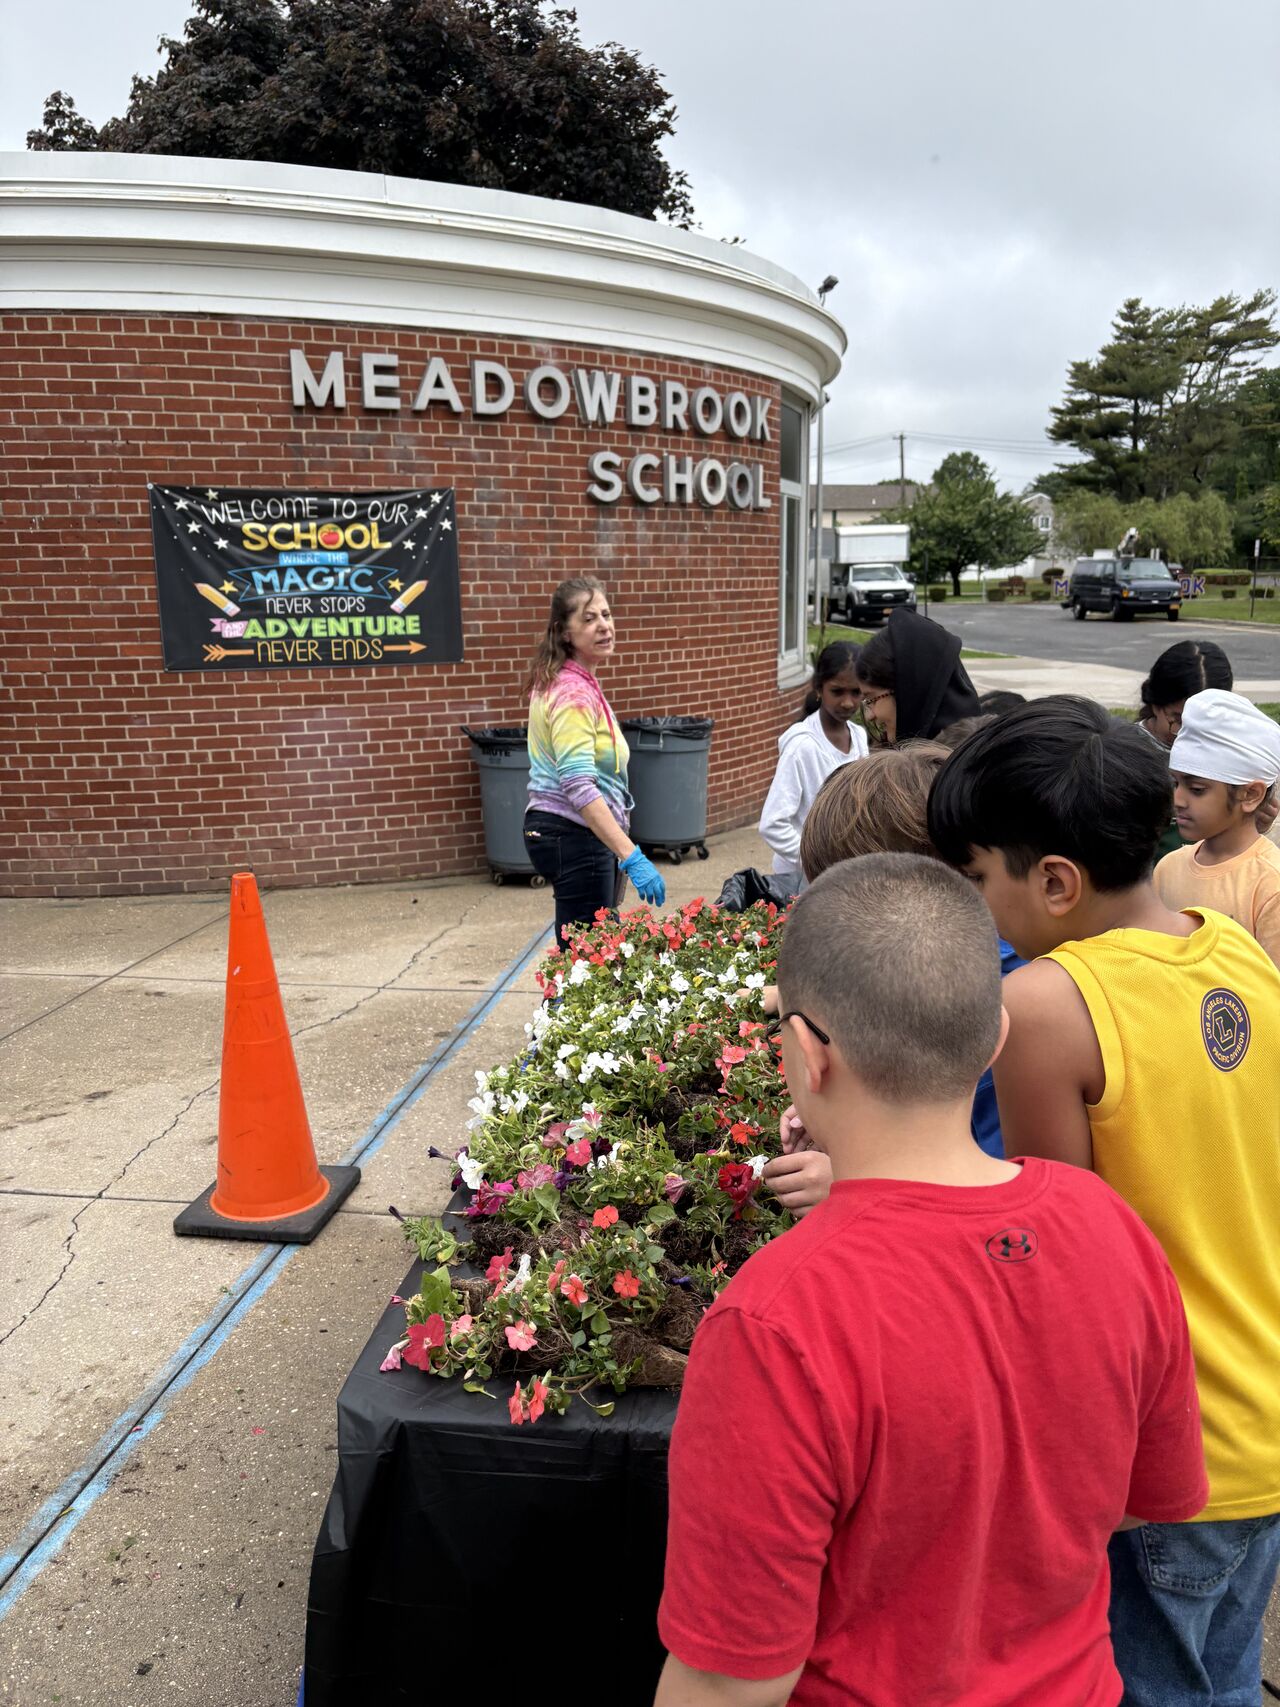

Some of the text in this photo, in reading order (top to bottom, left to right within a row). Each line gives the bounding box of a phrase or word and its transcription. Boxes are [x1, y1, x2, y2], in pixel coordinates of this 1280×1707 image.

[289, 348, 772, 441] MEADOWBROOK
[587, 451, 772, 510] SCHOOL
[201, 497, 409, 525] WELCOME TO OUR
[241, 522, 392, 550] SCHOOL
[282, 552, 346, 564] WHERE THE
[251, 567, 374, 595] MAGIC
[266, 596, 365, 614] NEVER STOPS
[225, 623, 244, 631] AND
[243, 615, 420, 639] ADVENTURE
[257, 638, 382, 662] NEVER ENDS
[1206, 997, 1223, 1020] ANGELES
[1224, 998, 1243, 1023] LAKERS
